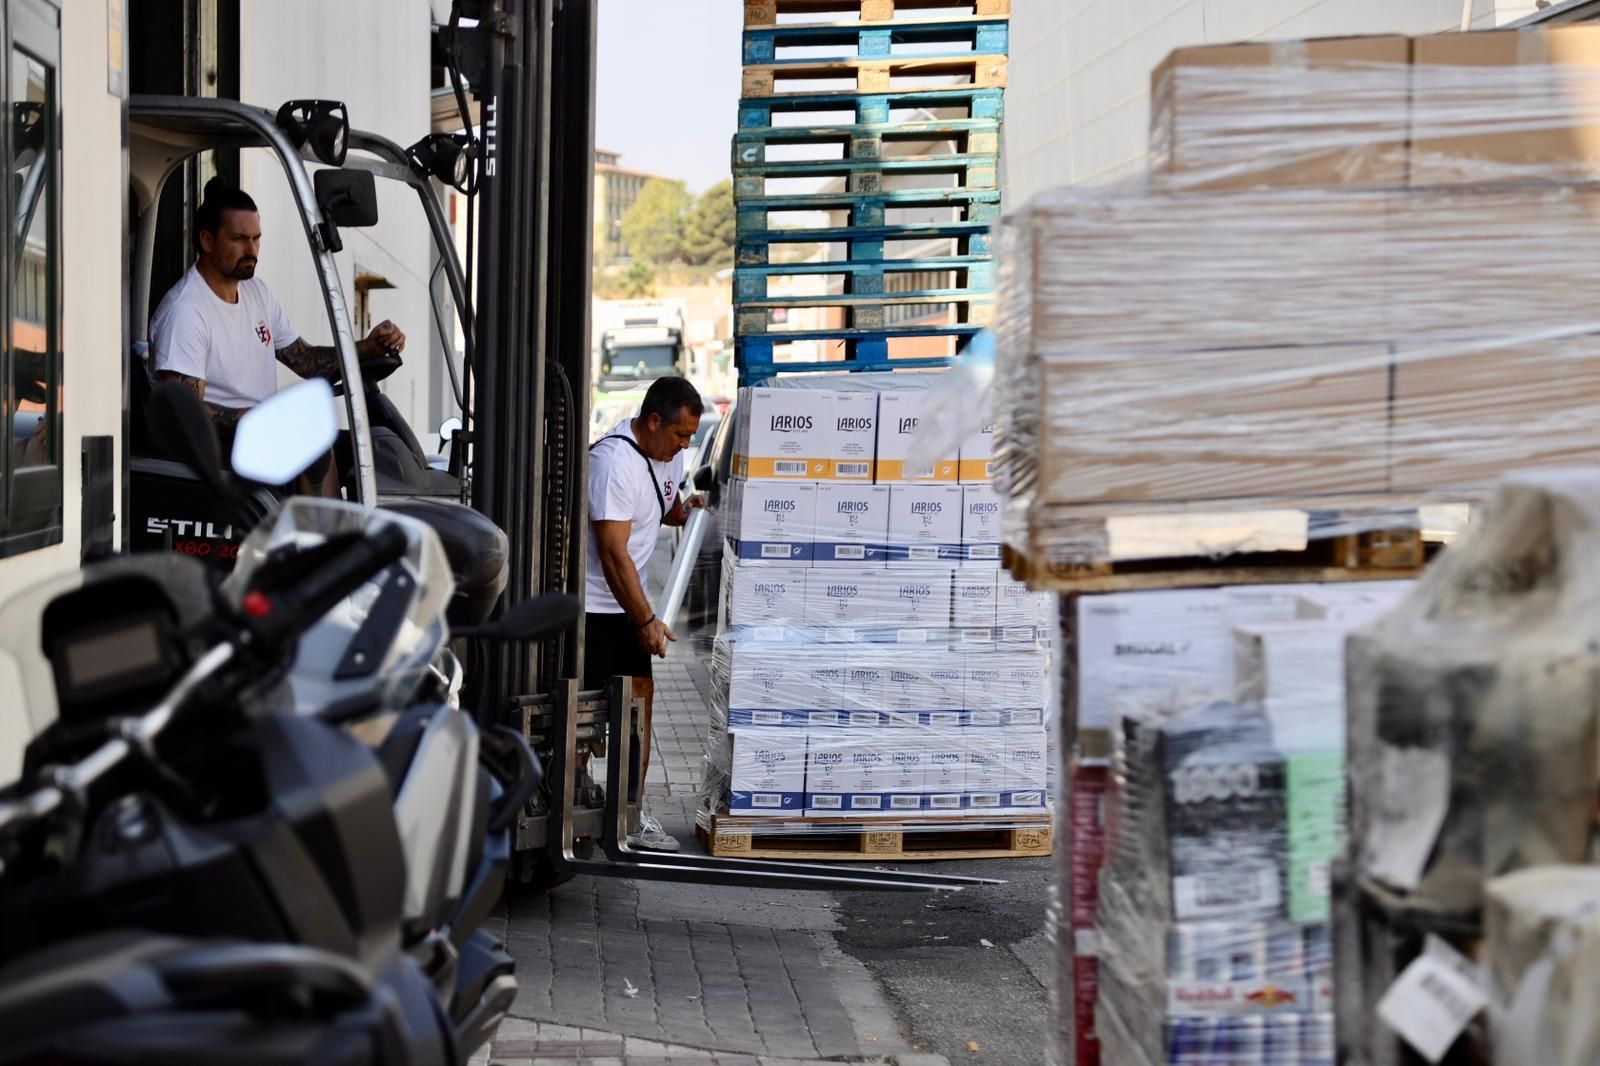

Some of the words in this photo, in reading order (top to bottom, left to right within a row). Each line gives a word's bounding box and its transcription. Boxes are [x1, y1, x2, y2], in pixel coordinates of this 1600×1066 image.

[485, 95, 497, 176] STILL
[770, 415, 813, 433] LARIOS
[837, 417, 872, 433] LARIOS
[764, 500, 795, 513] LARIOS
[837, 501, 869, 514] LARIOS
[911, 502, 942, 514] LARIOS
[969, 503, 998, 514] LARIOS
[754, 583, 786, 594] LARIOS
[827, 585, 858, 598] LARIOS
[899, 586, 931, 598] LARIOS
[851, 670, 880, 681] LARIOS
[930, 670, 960, 680] LARIOS
[814, 753, 843, 764] LARIOS
[853, 753, 882, 764] LARIOS
[1012, 750, 1041, 761] LARIOS
